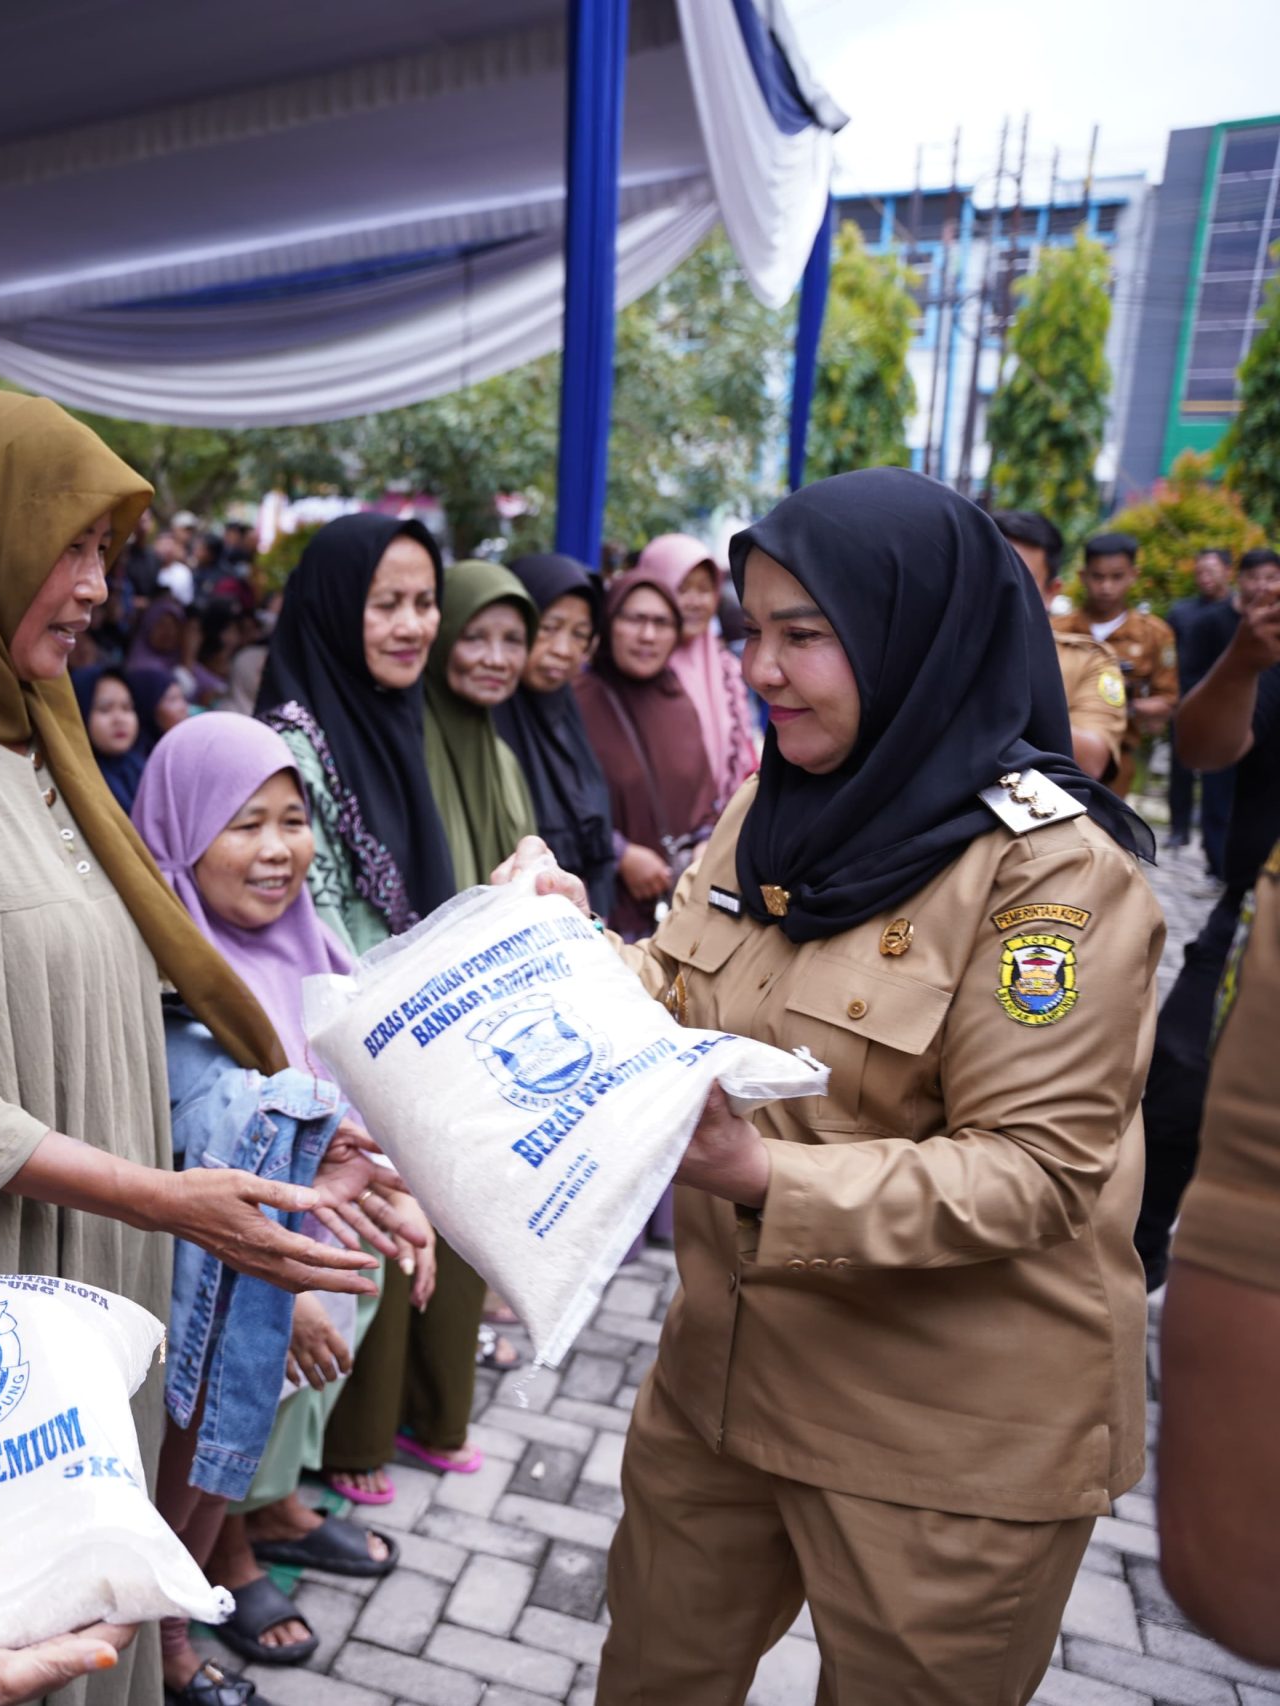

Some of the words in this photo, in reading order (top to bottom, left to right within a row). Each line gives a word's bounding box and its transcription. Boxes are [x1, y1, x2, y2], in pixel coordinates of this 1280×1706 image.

[363, 1010, 404, 1059] BERAS
[400, 966, 466, 1021] BANTUAN
[462, 921, 560, 978] PEMERINTAH
[411, 984, 485, 1048] BANDAR
[482, 952, 573, 1001] LAMPUNG
[511, 1101, 585, 1169] BERAS
[64, 1281, 110, 1311] KOTA
